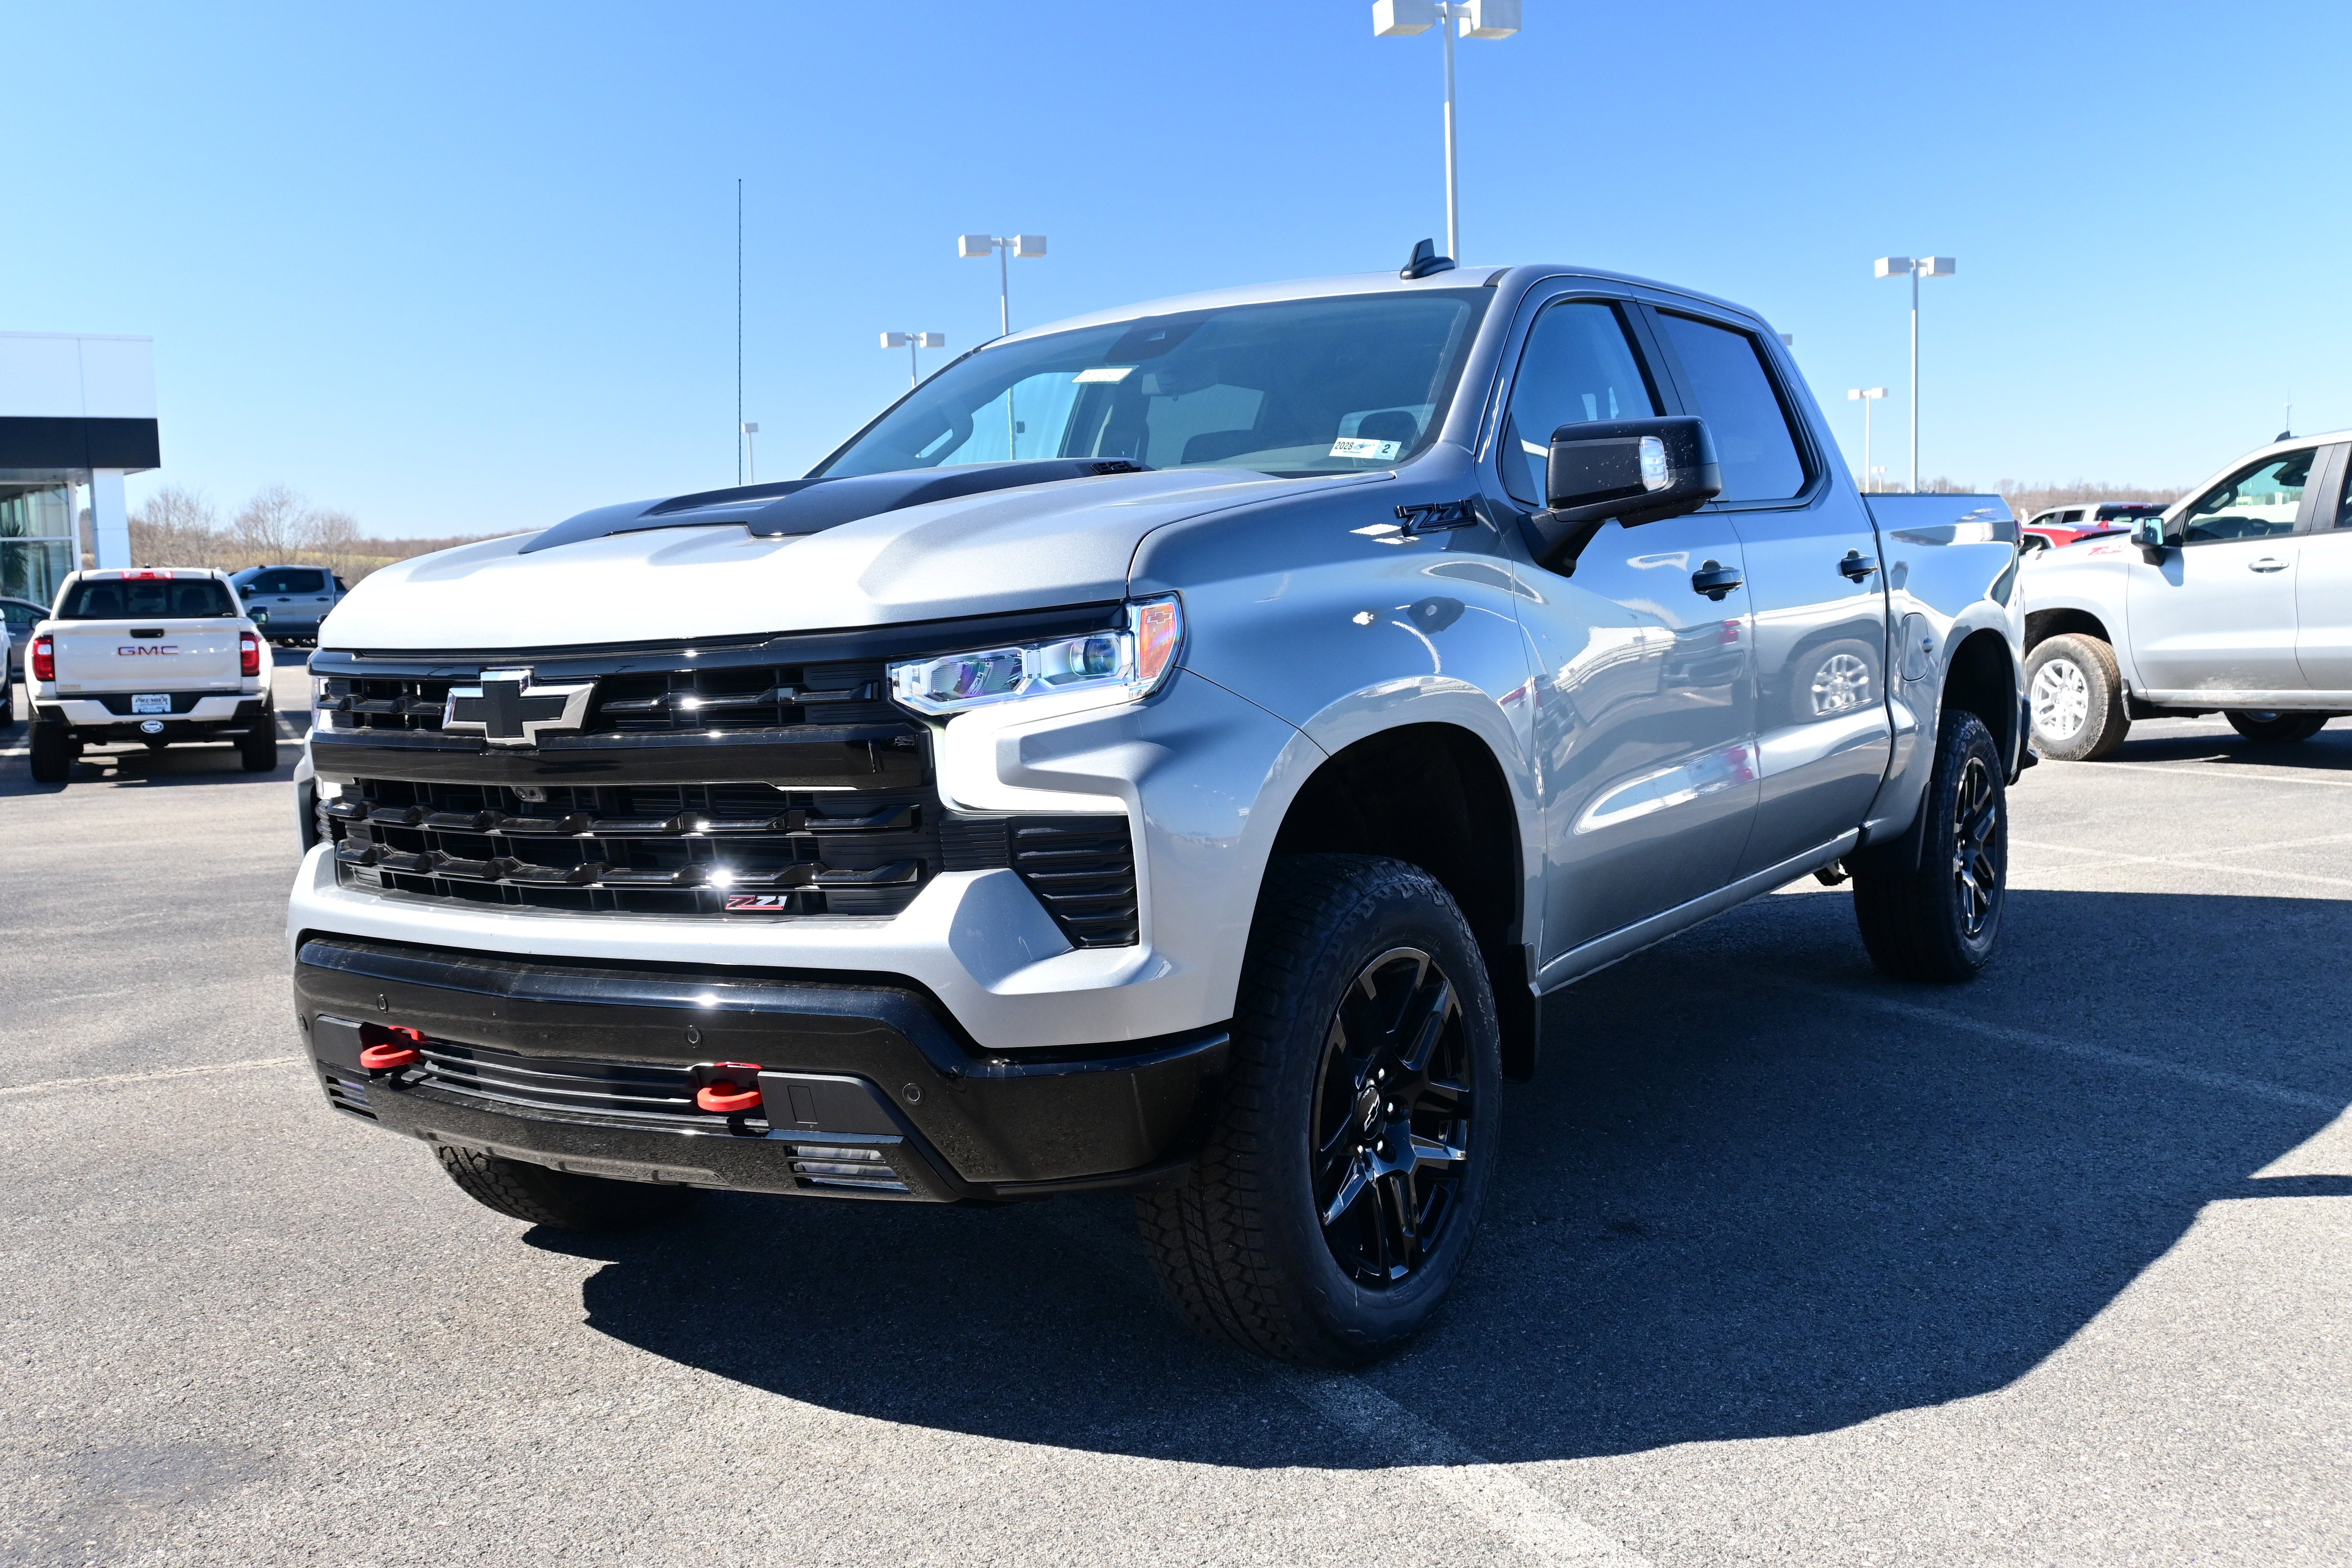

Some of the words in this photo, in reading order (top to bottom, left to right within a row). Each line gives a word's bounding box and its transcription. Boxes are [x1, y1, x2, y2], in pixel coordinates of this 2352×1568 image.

[1334, 441, 1354, 450] 2028
[1381, 444, 1391, 454] 2
[1395, 499, 1478, 537] Z71
[118, 646, 178, 656] GMC
[725, 895, 788, 910] Z71
